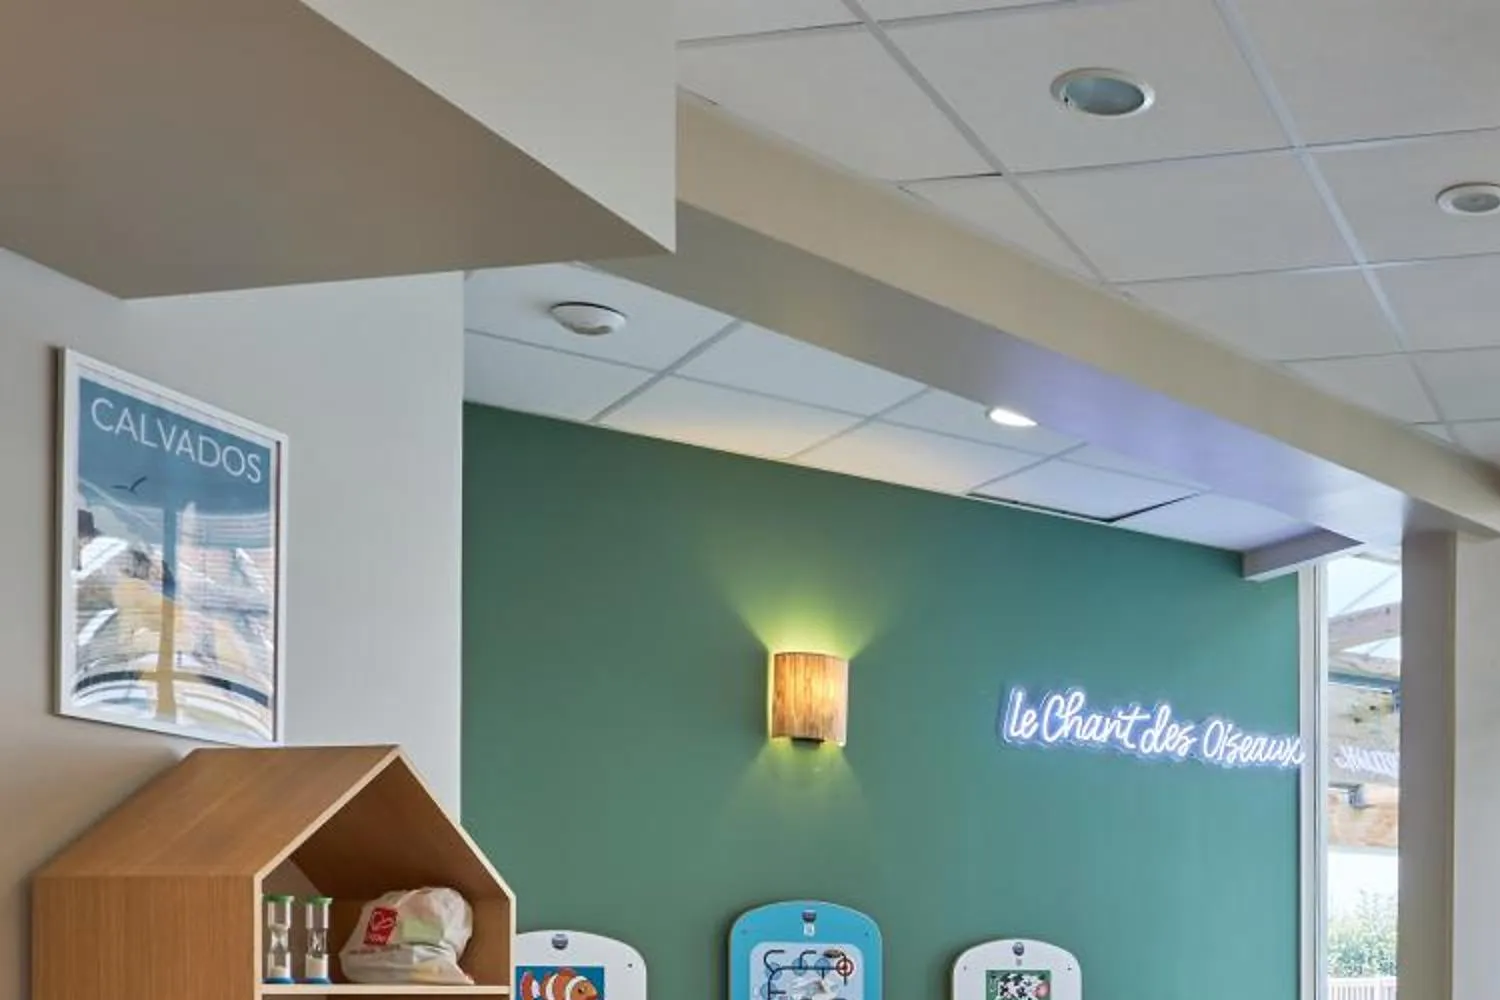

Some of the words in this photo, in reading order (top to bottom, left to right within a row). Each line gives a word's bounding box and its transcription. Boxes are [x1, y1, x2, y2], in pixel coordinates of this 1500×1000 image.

[91, 397, 262, 484] CALVADOS
[1043, 690, 1150, 749] Chant
[1140, 704, 1198, 757] des
[1203, 719, 1306, 766] Oiseaux
